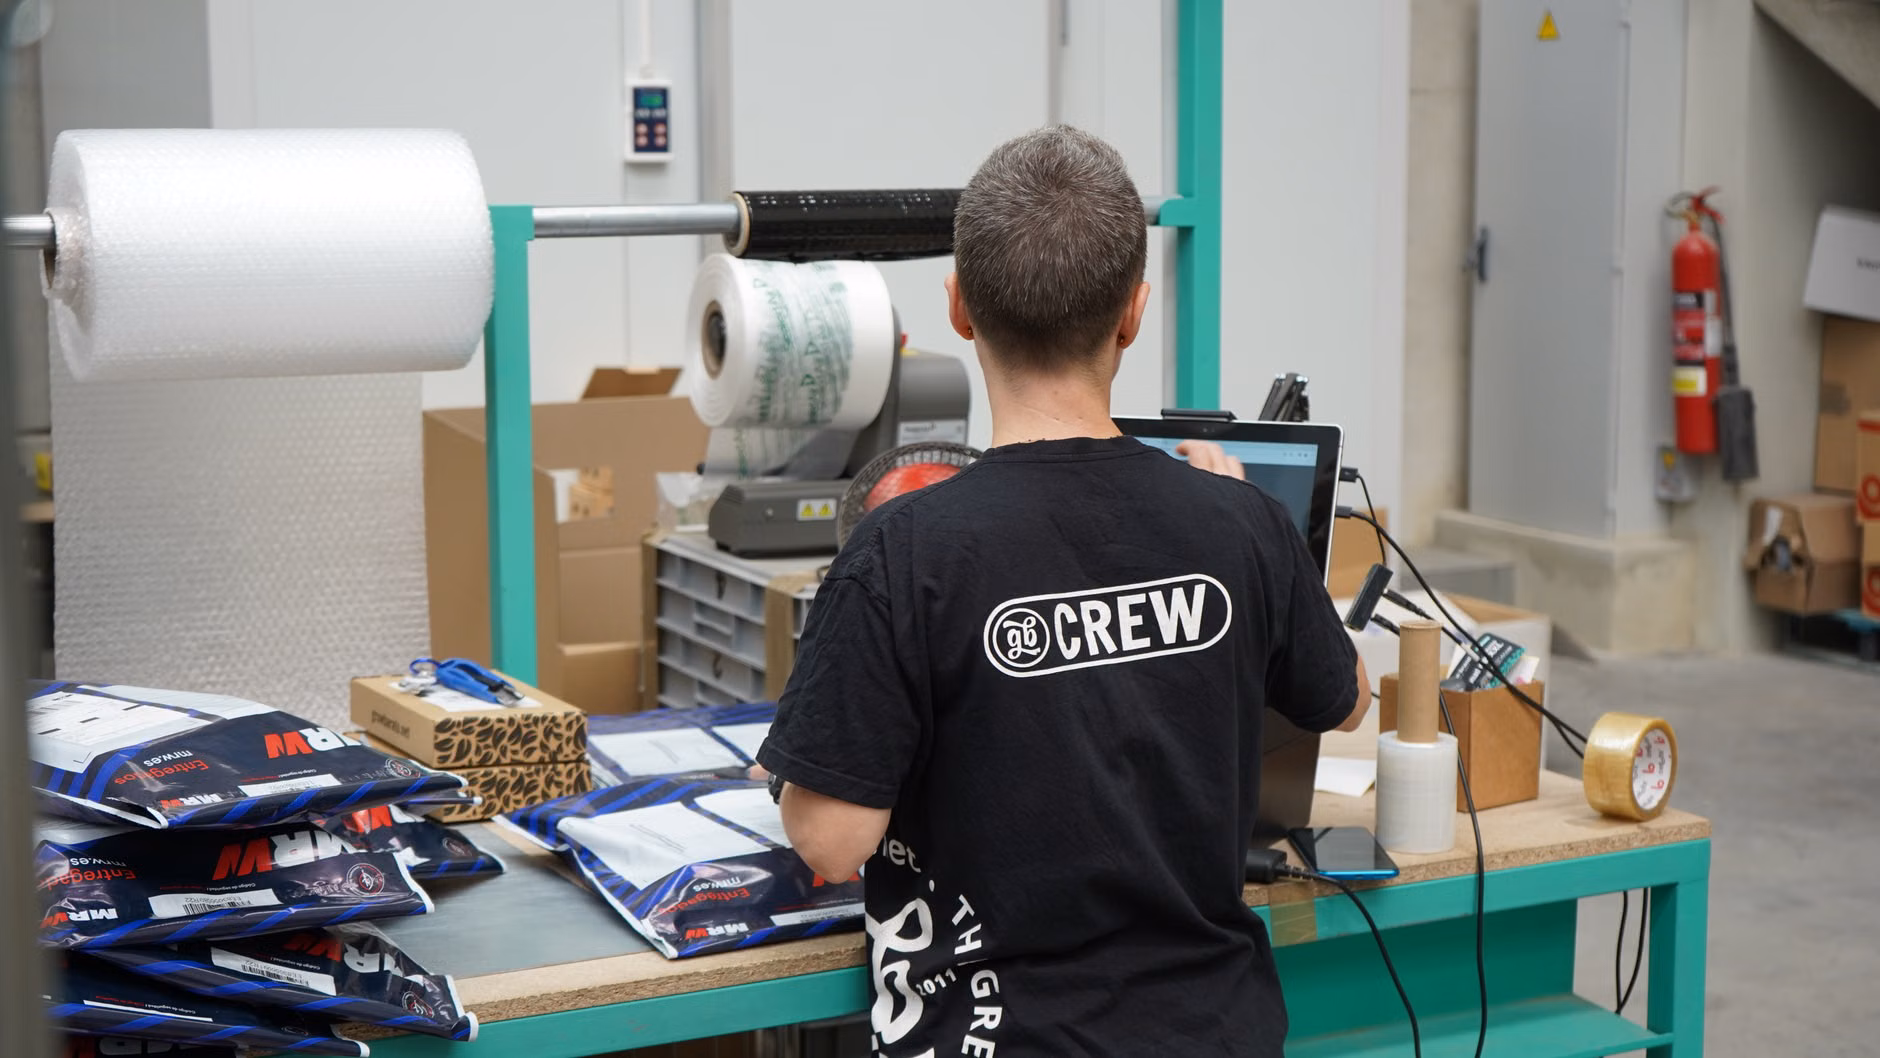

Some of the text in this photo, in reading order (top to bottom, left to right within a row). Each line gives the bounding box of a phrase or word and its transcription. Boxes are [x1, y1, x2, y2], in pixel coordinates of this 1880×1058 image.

[1054, 584, 1206, 660] CREW
[264, 728, 361, 759] RW
[144, 750, 193, 767] mrw.es
[114, 759, 209, 786] Entregos
[160, 793, 223, 809] MRW
[70, 857, 127, 868] mrw.es
[882, 836, 921, 873] et
[40, 867, 137, 891] Entregad
[40, 907, 119, 929] MRW
[684, 922, 749, 941] MRW
[917, 968, 957, 996] 2011
